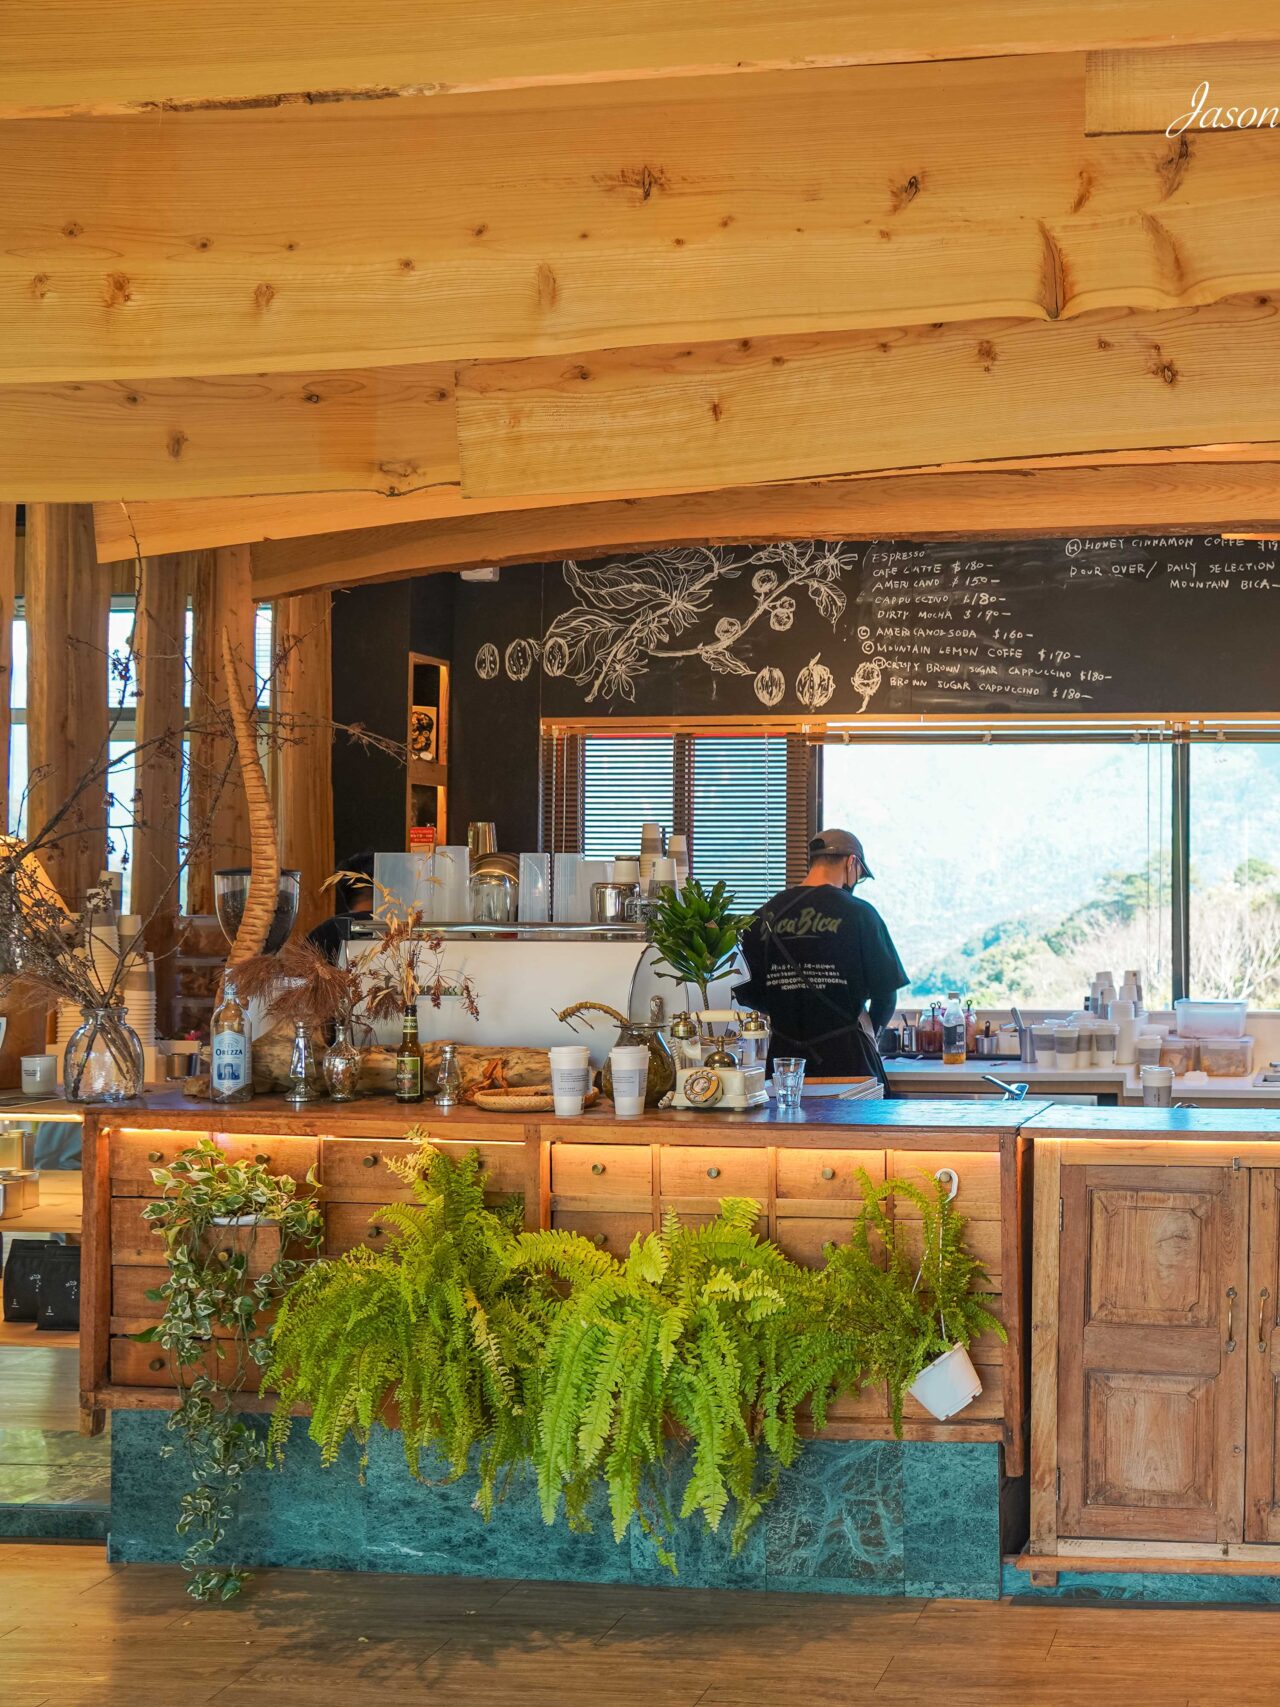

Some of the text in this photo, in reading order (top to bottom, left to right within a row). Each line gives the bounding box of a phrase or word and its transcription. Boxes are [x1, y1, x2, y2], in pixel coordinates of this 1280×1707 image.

[1084, 539, 1124, 550] HONEY
[1132, 538, 1194, 548] CINNAMON
[872, 550, 925, 566] ESPRESSO
[873, 567, 898, 578] CAFE
[903, 564, 942, 574] LATTE
[1167, 562, 1197, 578] DAILY
[1208, 560, 1275, 574] SELECTION
[1170, 579, 1230, 590] MOUNTAIN
[877, 610, 910, 620] DIRTY
[918, 610, 953, 620] MOCHA
[877, 643, 931, 654] MOUNTAIN
[939, 646, 979, 656] LEMON
[987, 647, 1023, 659] COFFE
[926, 663, 960, 674] BROWN
[968, 666, 998, 674] SUGAR
[1008, 666, 1072, 678] CAPPUCCINO
[937, 680, 971, 690] SUGAR
[978, 682, 1040, 696] CAPPUCCINO
